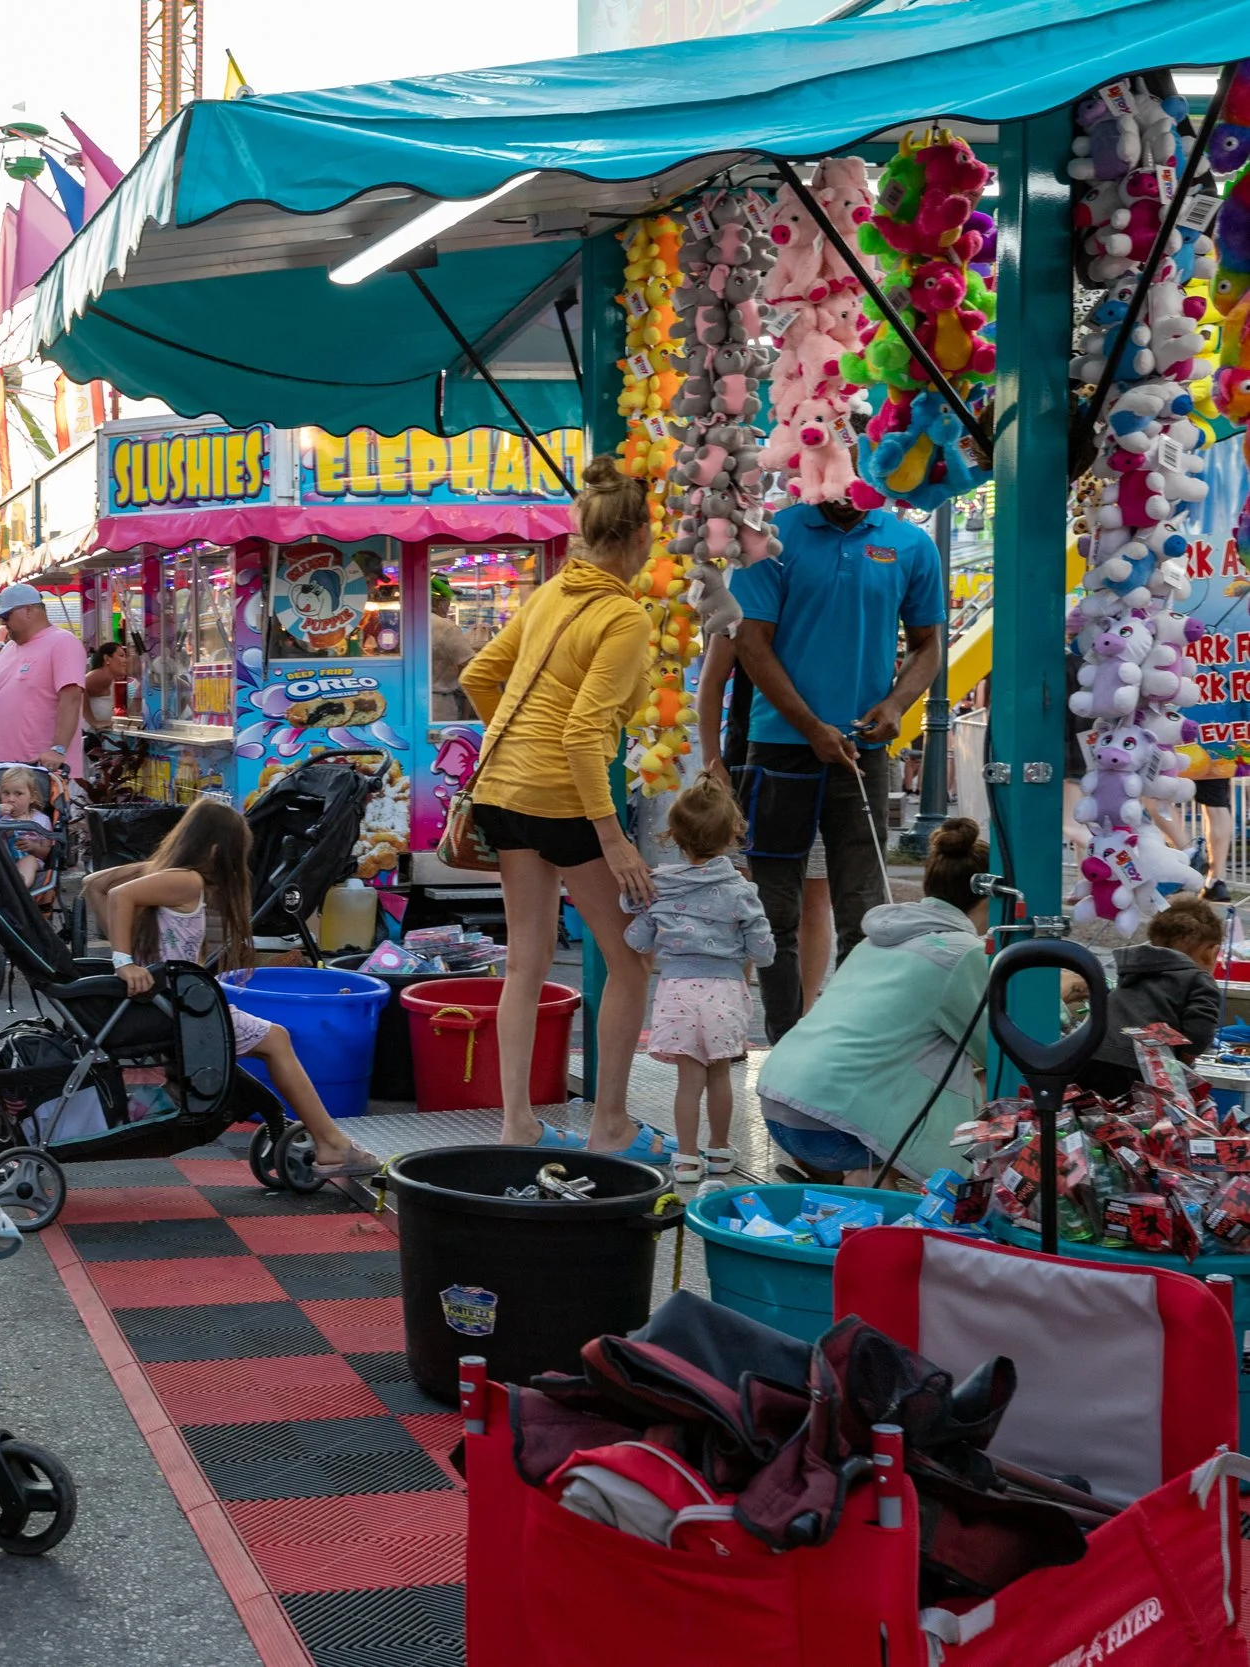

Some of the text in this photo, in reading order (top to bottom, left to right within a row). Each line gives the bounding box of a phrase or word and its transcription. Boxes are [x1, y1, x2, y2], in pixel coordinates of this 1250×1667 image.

[114, 431, 264, 506] SLUSHIES
[318, 429, 586, 496] ELEPHANT
[302, 608, 355, 631] PUPPIE
[286, 668, 352, 680] DEEP FRIED
[287, 676, 378, 698] OREO
[1106, 1598, 1162, 1655] FLYER
